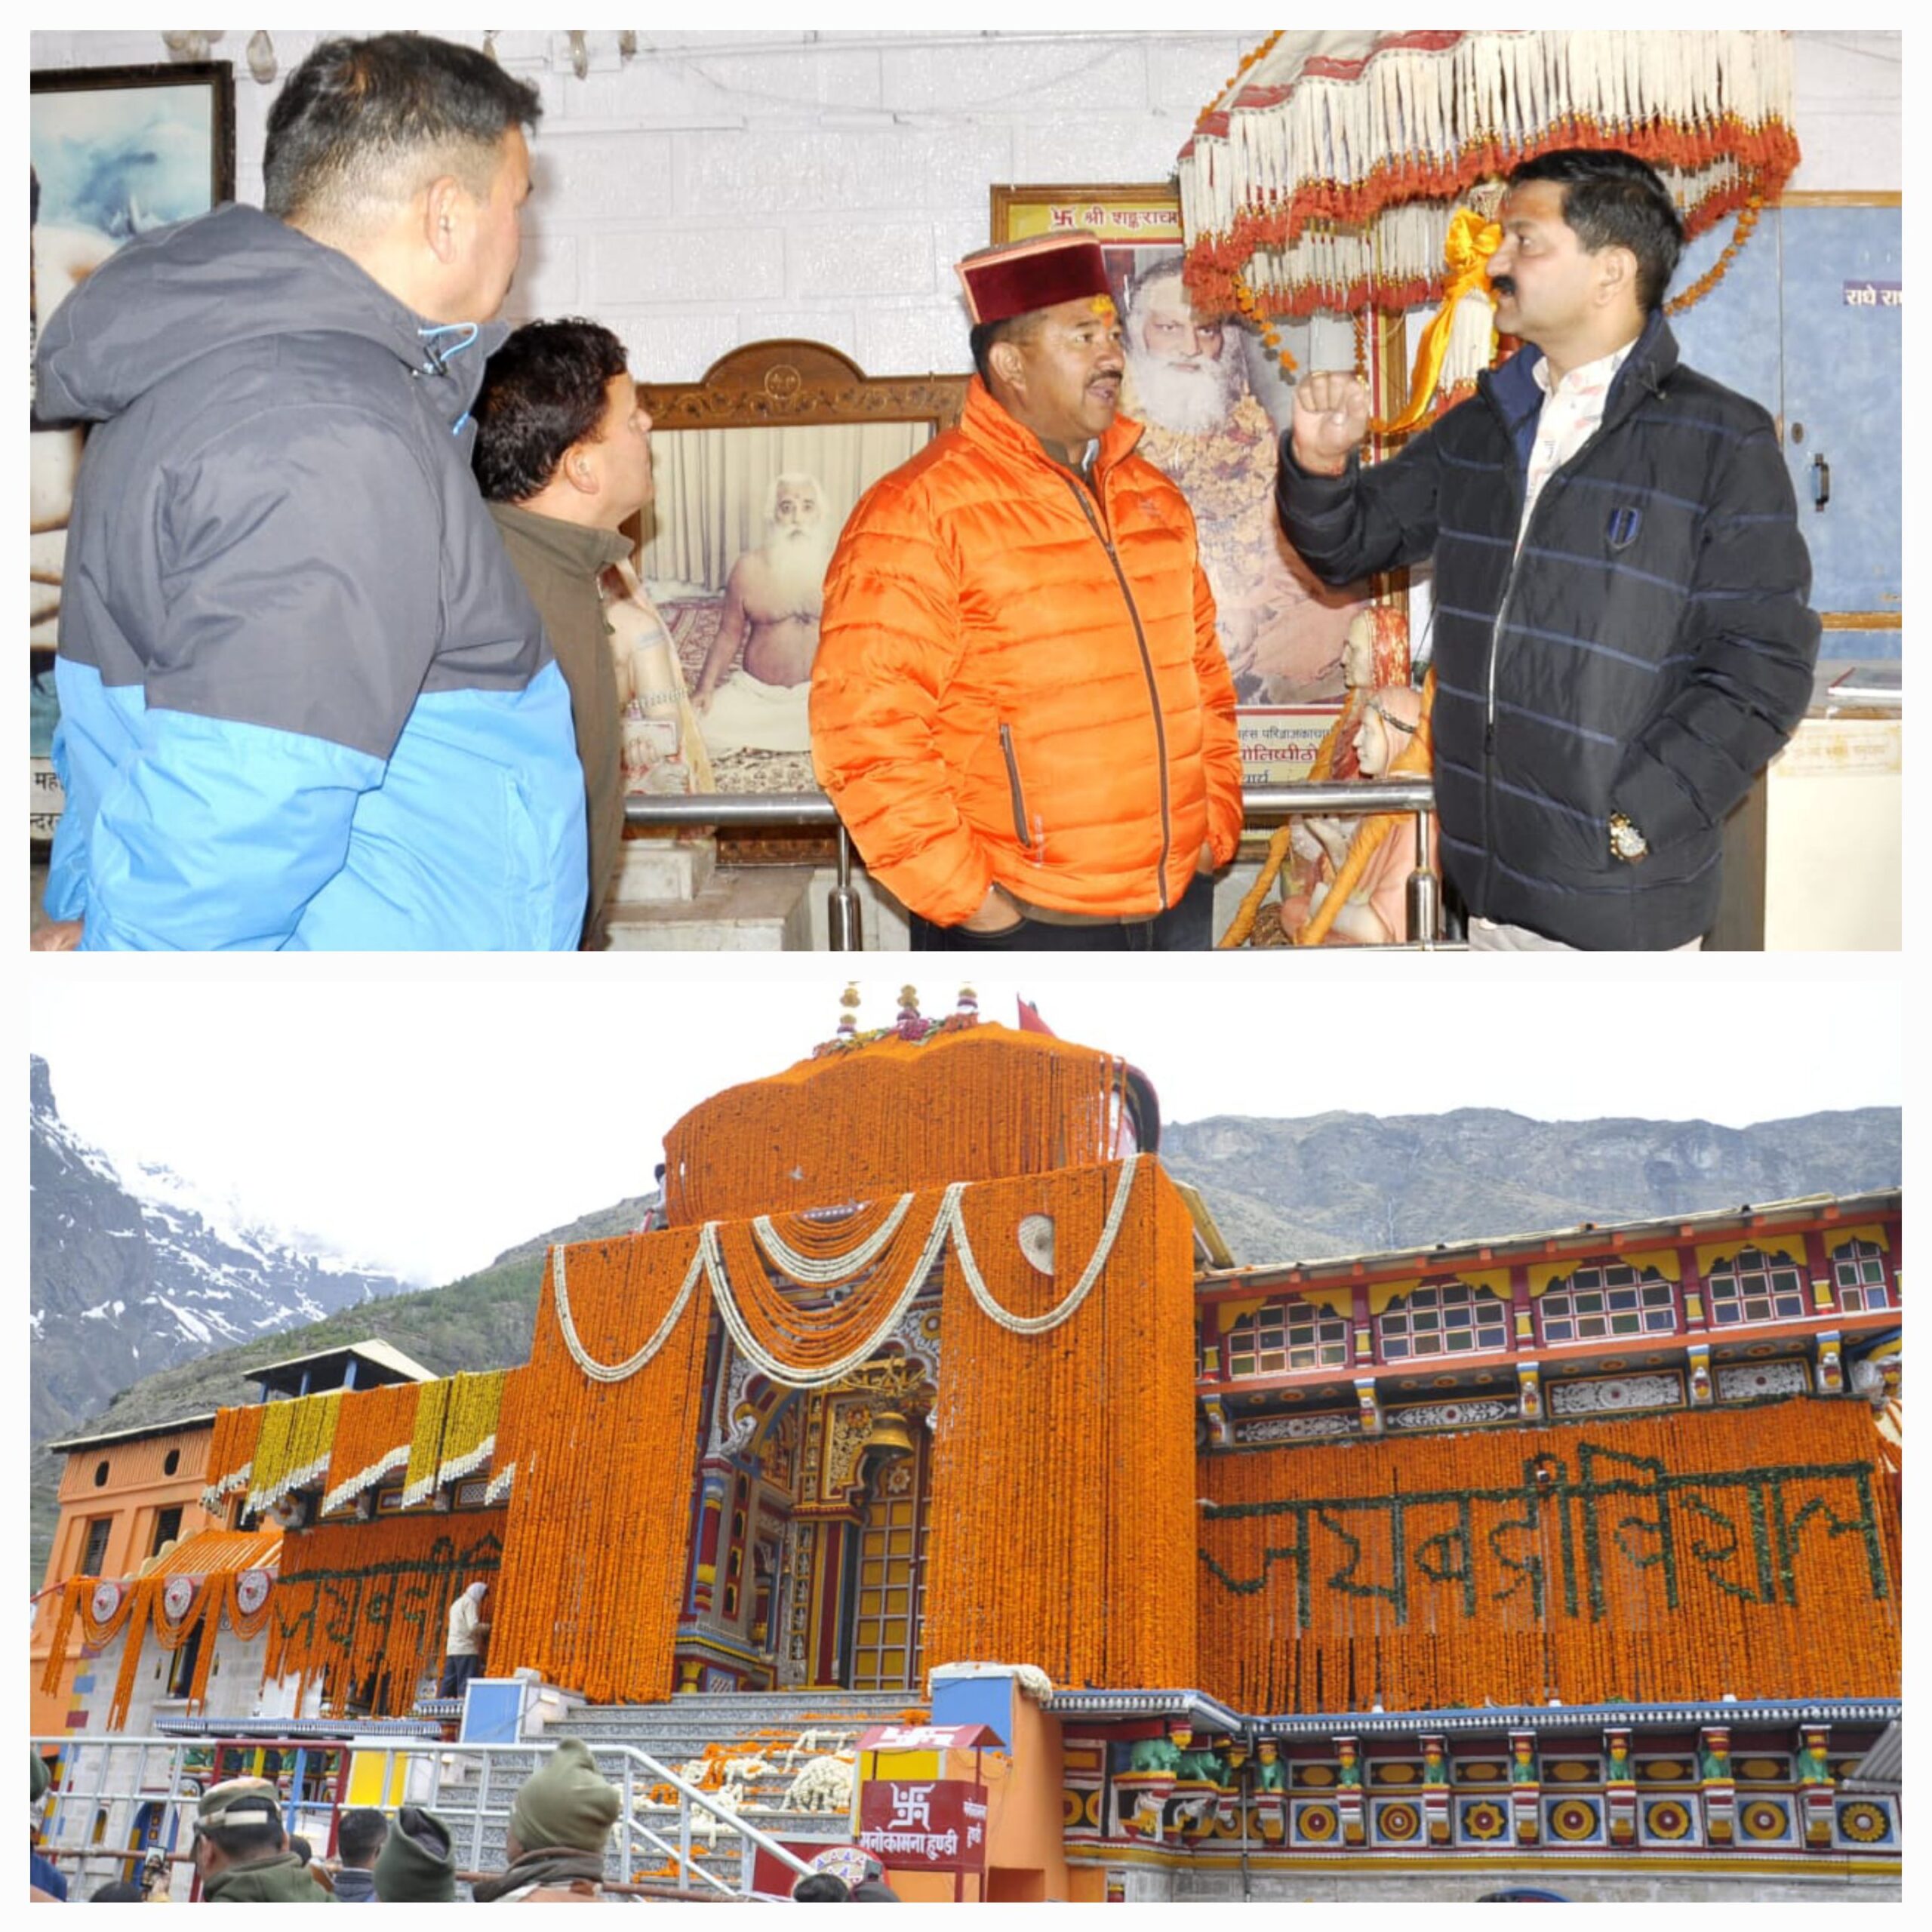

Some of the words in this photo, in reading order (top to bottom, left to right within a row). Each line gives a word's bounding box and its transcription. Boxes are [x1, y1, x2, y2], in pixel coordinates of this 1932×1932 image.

[1084, 205, 1104, 225] श्री
[1846, 284, 1877, 306] राधे
[1881, 288, 1902, 306] रा
[859, 1826, 924, 1854] मनोकामना
